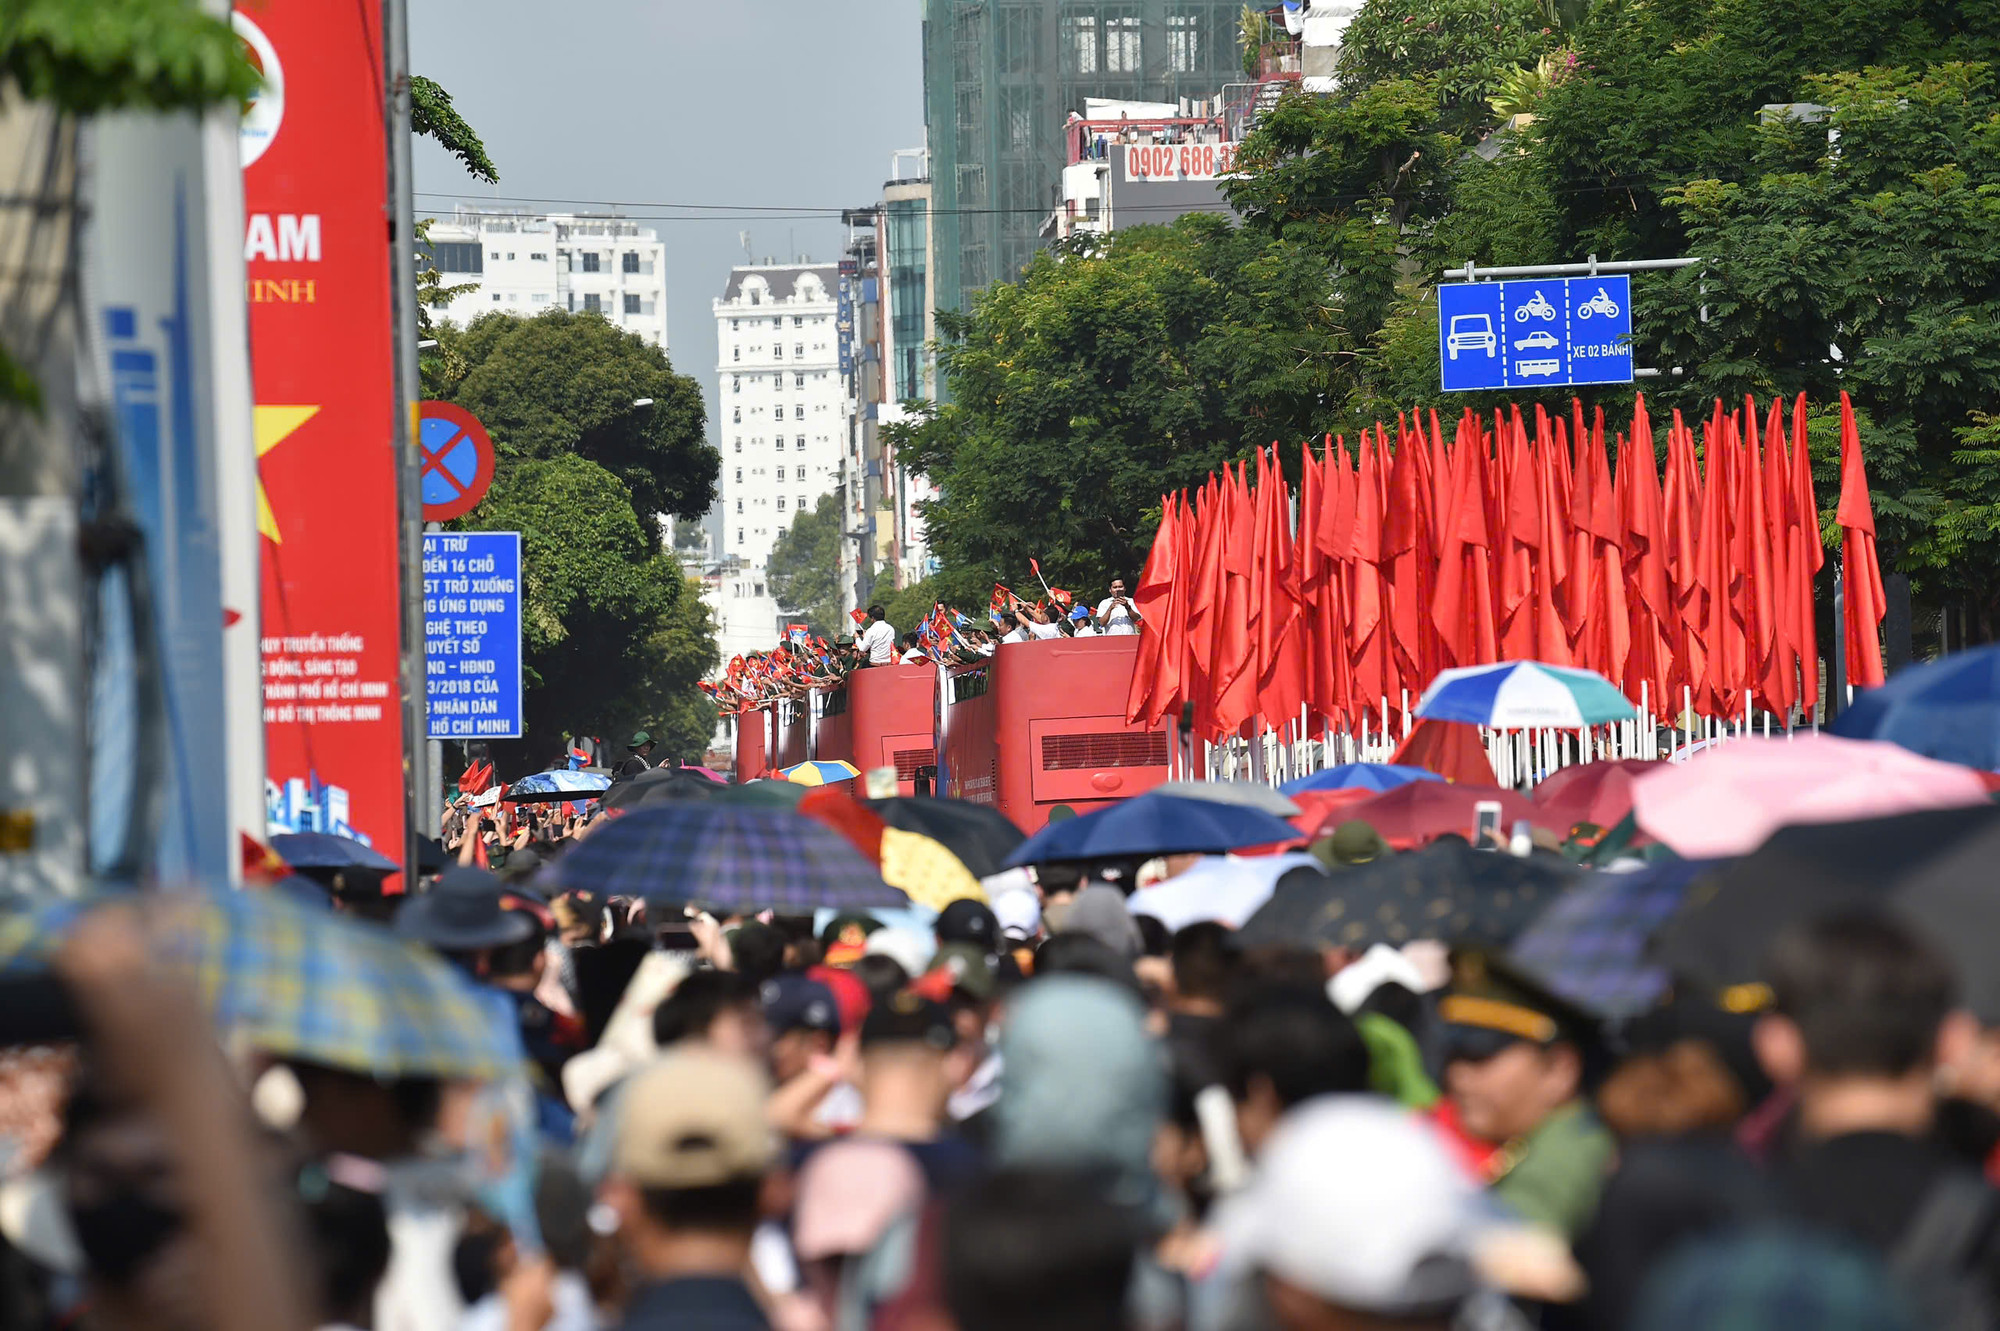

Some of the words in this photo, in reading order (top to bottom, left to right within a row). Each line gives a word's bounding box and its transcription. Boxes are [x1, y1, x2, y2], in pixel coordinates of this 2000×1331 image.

[1129, 147, 1174, 177] 0902
[1180, 146, 1213, 175] 688
[246, 279, 317, 303] INH
[1573, 345, 1586, 358] XE
[1588, 344, 1600, 357] 02
[1602, 340, 1628, 357] BÁNH
[441, 535, 469, 553] TRỪ
[451, 559, 465, 573] 16
[468, 554, 495, 573] CHỖ
[443, 575, 469, 593] TRỞ
[471, 575, 515, 593] XUỐNG
[439, 596, 467, 613] ỨNG
[470, 599, 505, 616] DỤNG
[454, 621, 488, 635] THEO
[424, 635, 460, 654] UYẾT
[462, 635, 482, 654] SỐ
[427, 660, 446, 675] NQ
[460, 660, 495, 674] HĐND
[360, 681, 389, 698] MINH
[427, 679, 470, 694] 3/2018
[473, 676, 499, 693] CỦA
[353, 704, 382, 721] MINH
[433, 697, 469, 714] NHÂN
[471, 697, 498, 714] DÂN
[431, 716, 449, 734] HỒ
[452, 716, 473, 734] CHÍ
[476, 719, 510, 734] MINH
